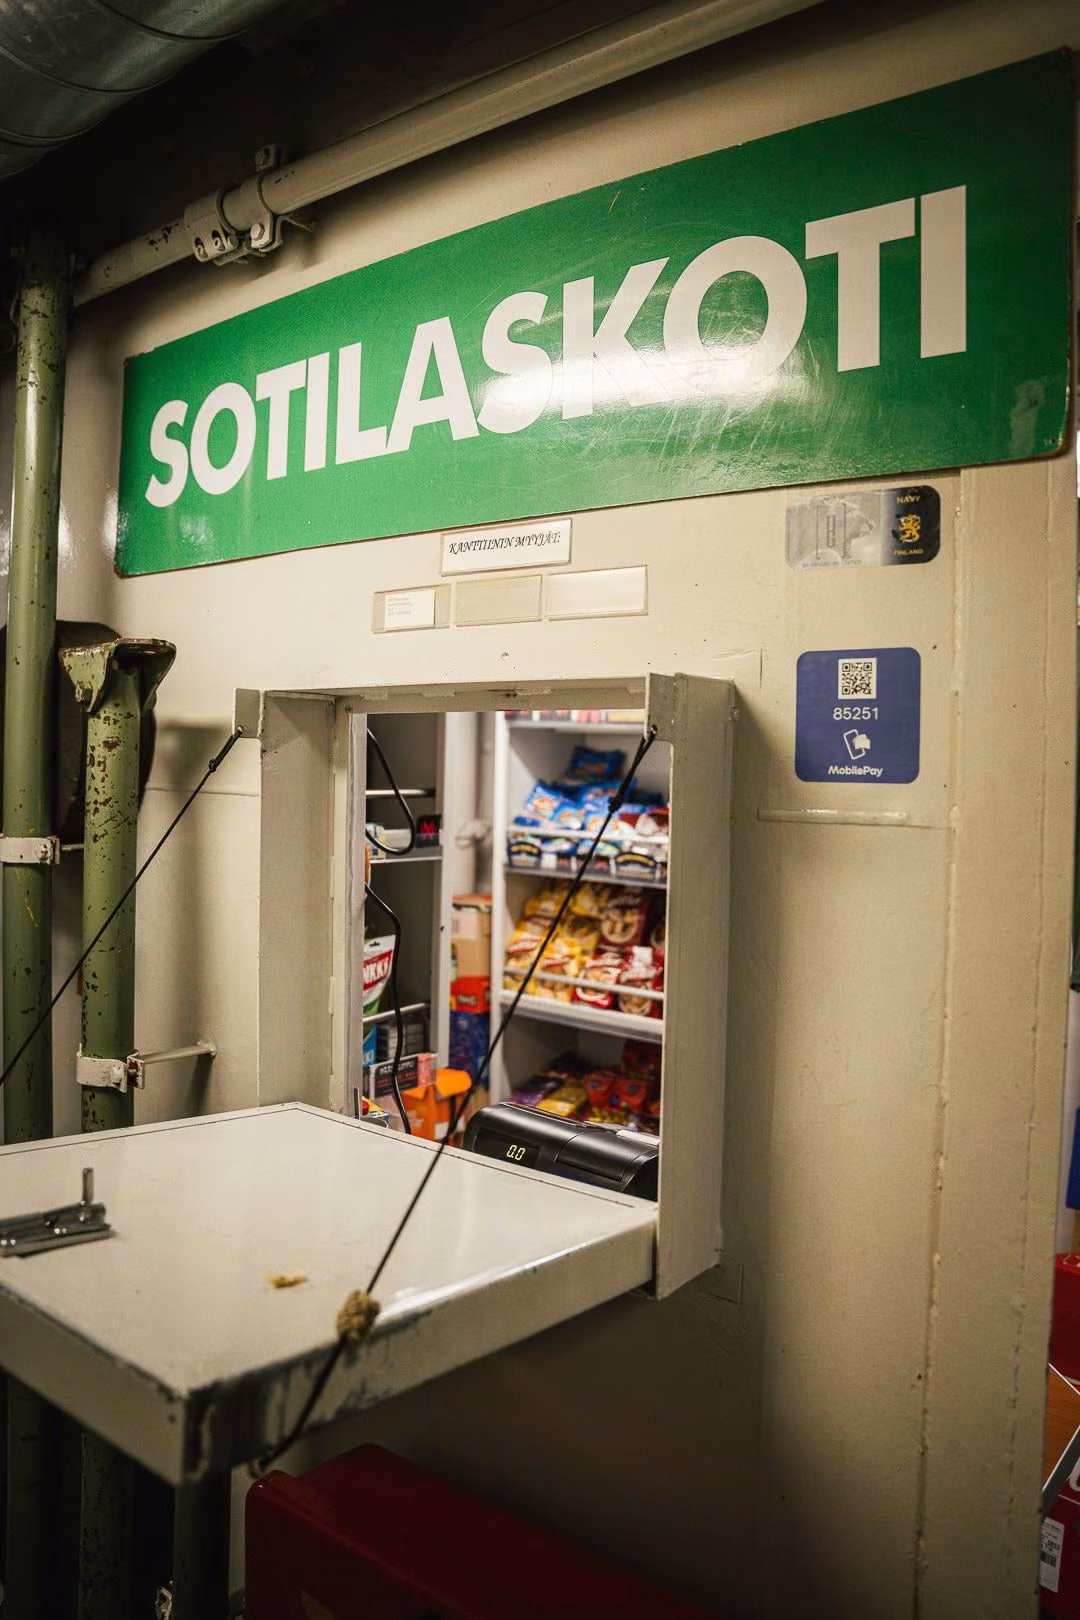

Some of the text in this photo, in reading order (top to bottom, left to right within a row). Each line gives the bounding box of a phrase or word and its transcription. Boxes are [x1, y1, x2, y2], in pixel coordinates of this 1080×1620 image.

[145, 185, 967, 508] SOTILASKOTI
[896, 495, 921, 505] NAVY
[448, 531, 561, 554] KANTTIININ MYYJÄT:
[833, 707, 879, 720] 85251
[827, 765, 883, 778] MobilePay
[506, 1144, 526, 1161] 0.0
